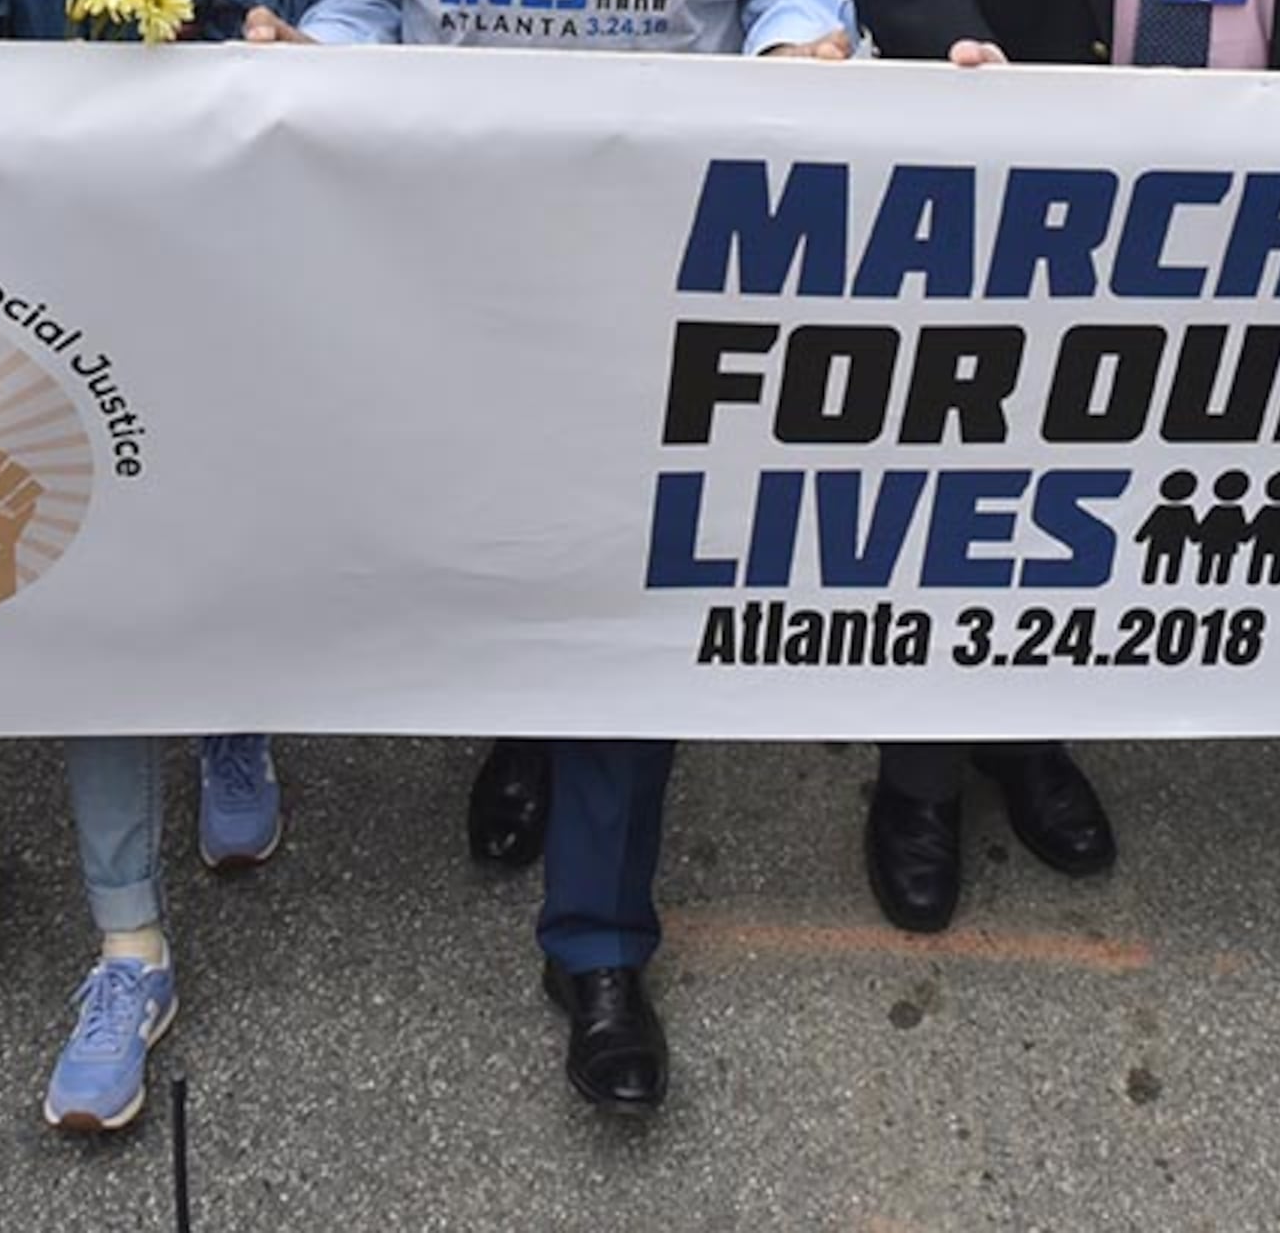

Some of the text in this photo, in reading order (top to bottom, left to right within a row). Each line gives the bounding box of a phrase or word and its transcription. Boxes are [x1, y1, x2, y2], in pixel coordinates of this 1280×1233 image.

[441, 13, 579, 37] ATLANTA
[70, 351, 143, 479] Justice
[661, 321, 1028, 445] FOR
[644, 468, 1134, 589] LIVES
[697, 601, 1268, 667] Atlanta 3.24.2018
